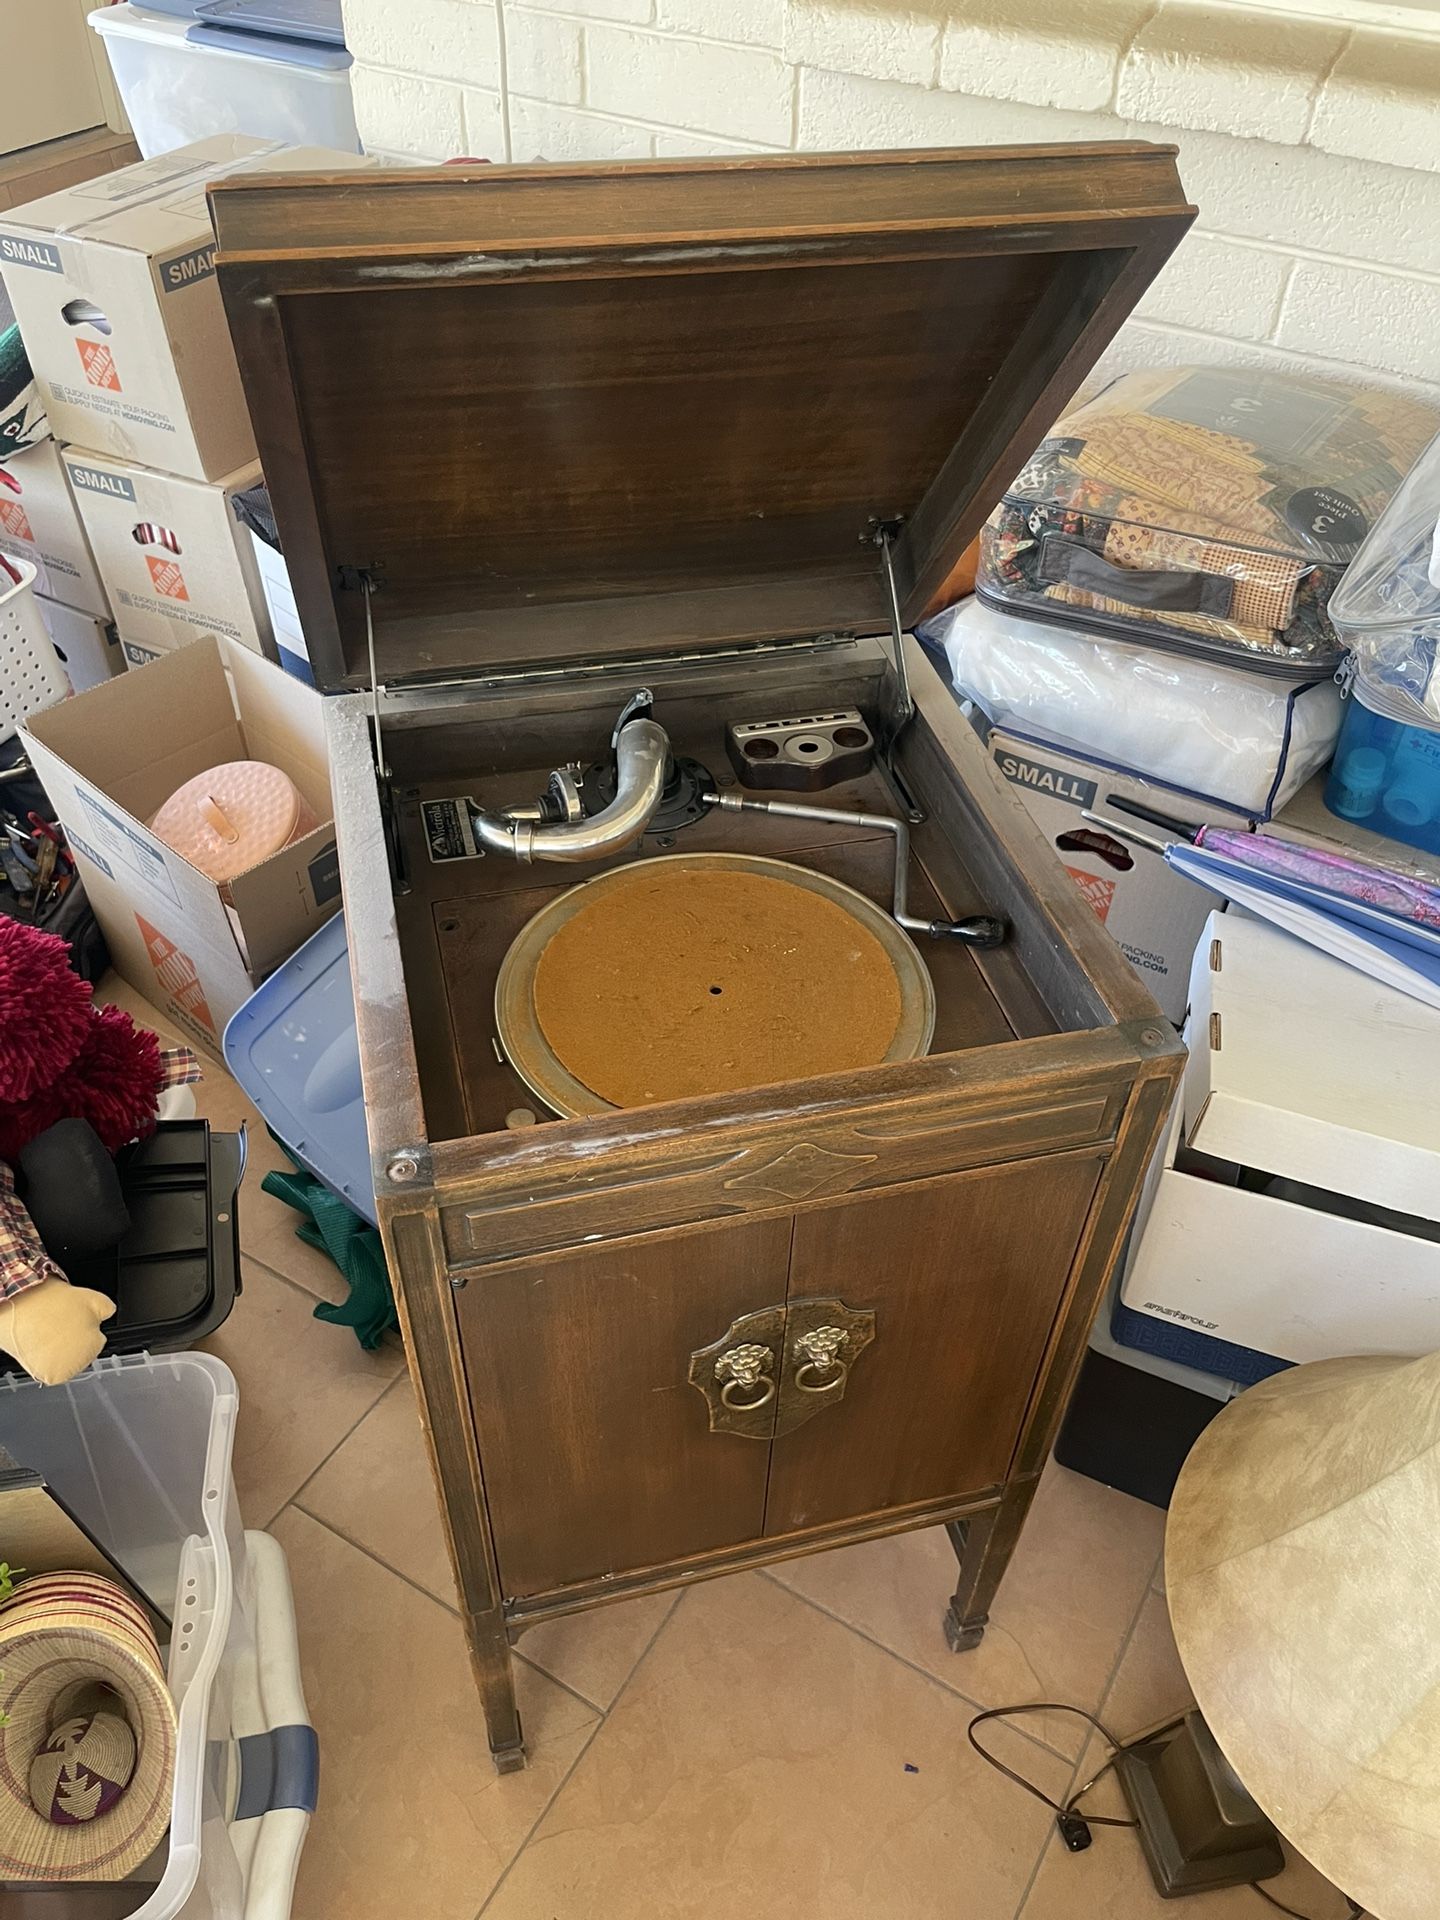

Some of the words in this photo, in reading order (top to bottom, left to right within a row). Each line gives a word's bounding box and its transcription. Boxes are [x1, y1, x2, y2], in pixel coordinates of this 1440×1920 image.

[2, 239, 57, 267] SMALL
[169, 251, 215, 284] SMAL
[74, 469, 130, 497] SMALL
[1313, 490, 1333, 502] Set
[1318, 501, 1348, 520] Piece
[1332, 498, 1361, 518] Quilt
[1311, 515, 1336, 534] 3
[1001, 758, 1085, 802] SMALL
[428, 804, 446, 840] Victrola
[68, 829, 111, 875] SMALL
[1121, 943, 1165, 965] PACKING
[1123, 952, 1169, 976] NG.COM
